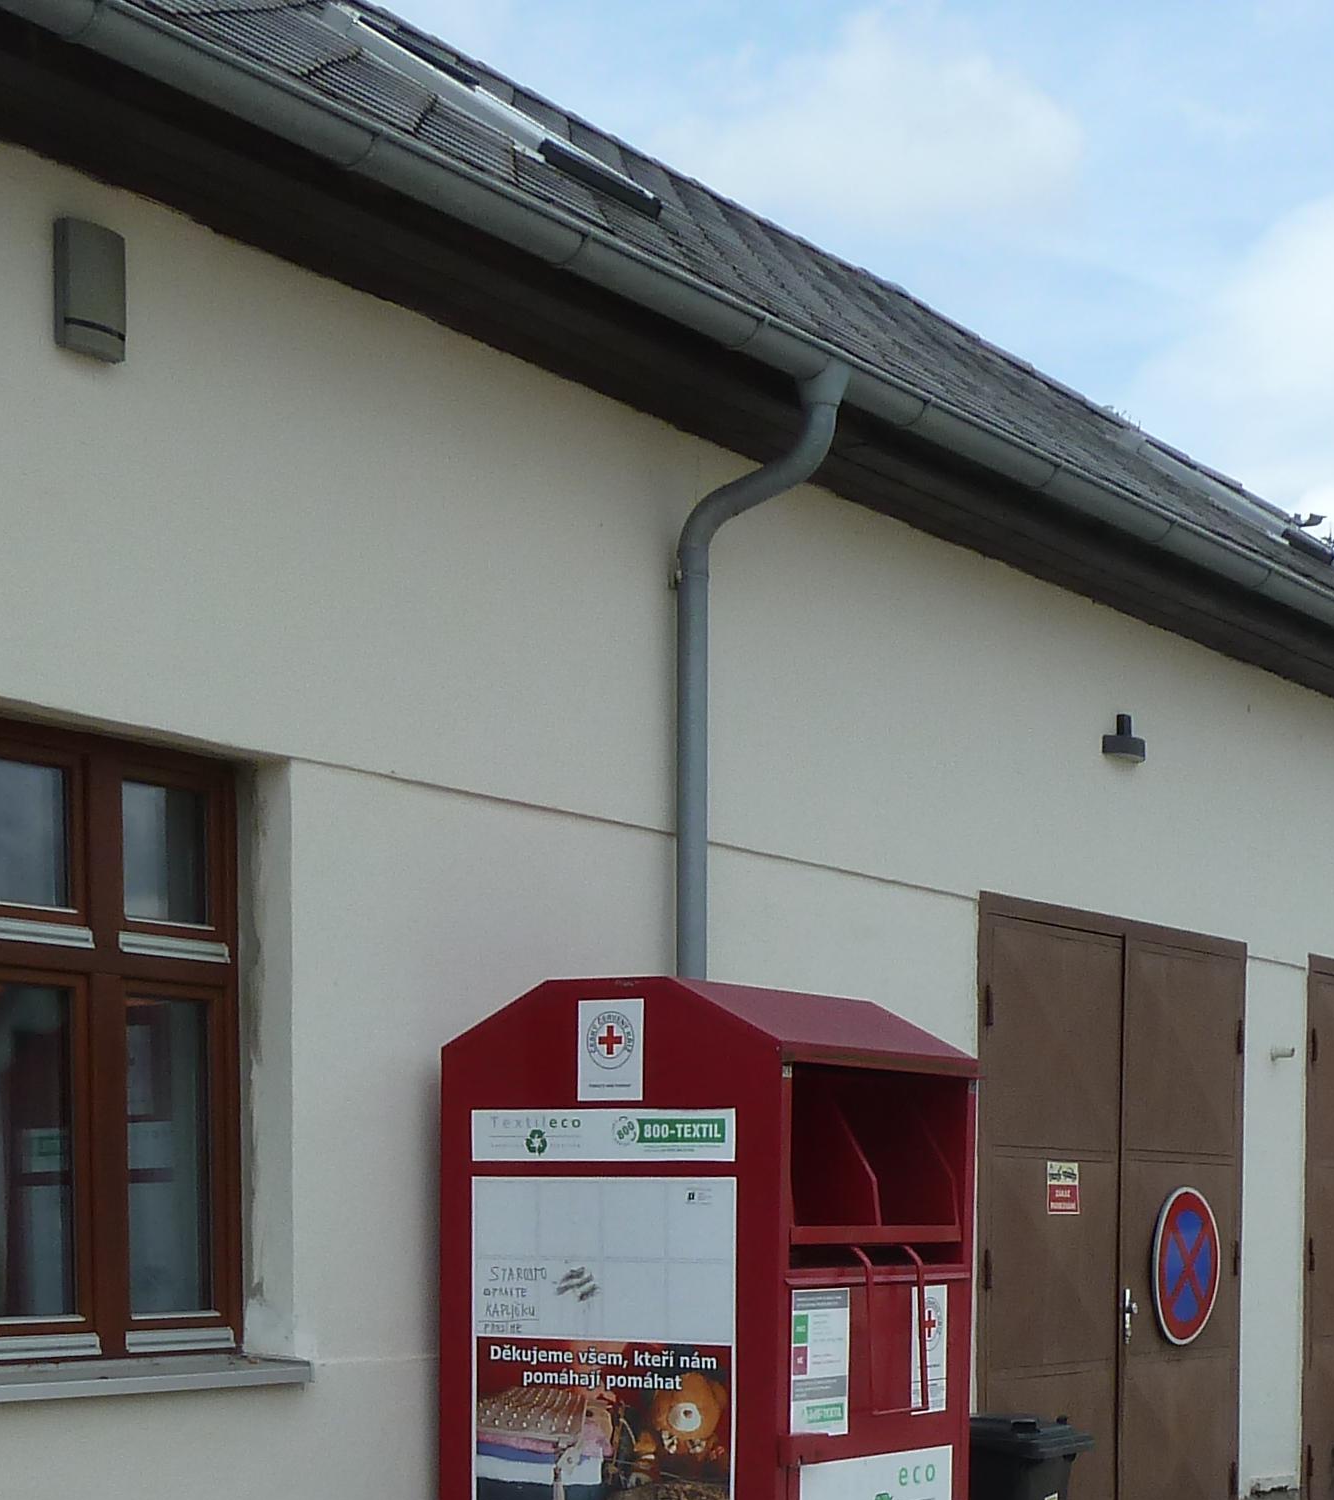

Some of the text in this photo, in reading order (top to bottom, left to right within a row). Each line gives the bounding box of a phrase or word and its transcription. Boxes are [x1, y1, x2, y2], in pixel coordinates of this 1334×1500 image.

[643, 1123, 722, 1139] 800-TEXTIL
[489, 1345, 718, 1370] Děkujeme všem, kteří nám
[522, 1368, 683, 1391] pomáhají pomáhat
[898, 1463, 936, 1487] eco
